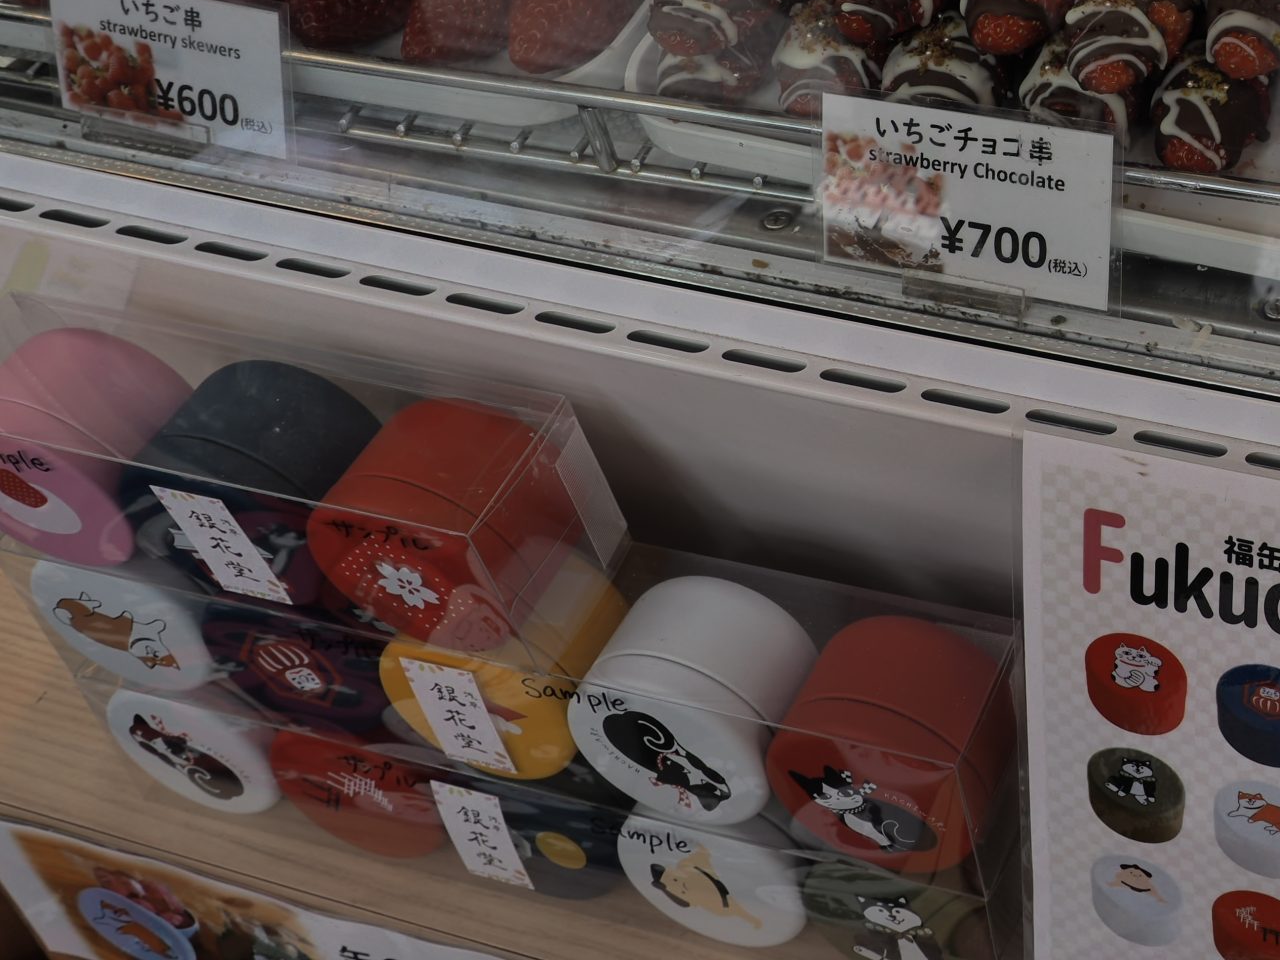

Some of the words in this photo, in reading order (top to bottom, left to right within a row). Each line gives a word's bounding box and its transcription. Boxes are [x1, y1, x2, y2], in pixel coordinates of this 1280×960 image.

[99, 18, 178, 49] strawberry
[181, 35, 242, 60] skewers
[154, 78, 240, 126] ¥600
[875, 117, 1054, 166] いちごチョコ串
[869, 147, 968, 180] strawberry
[973, 162, 1066, 192] Chocolate
[939, 216, 1048, 268] ¥700
[521, 677, 628, 714] Sample
